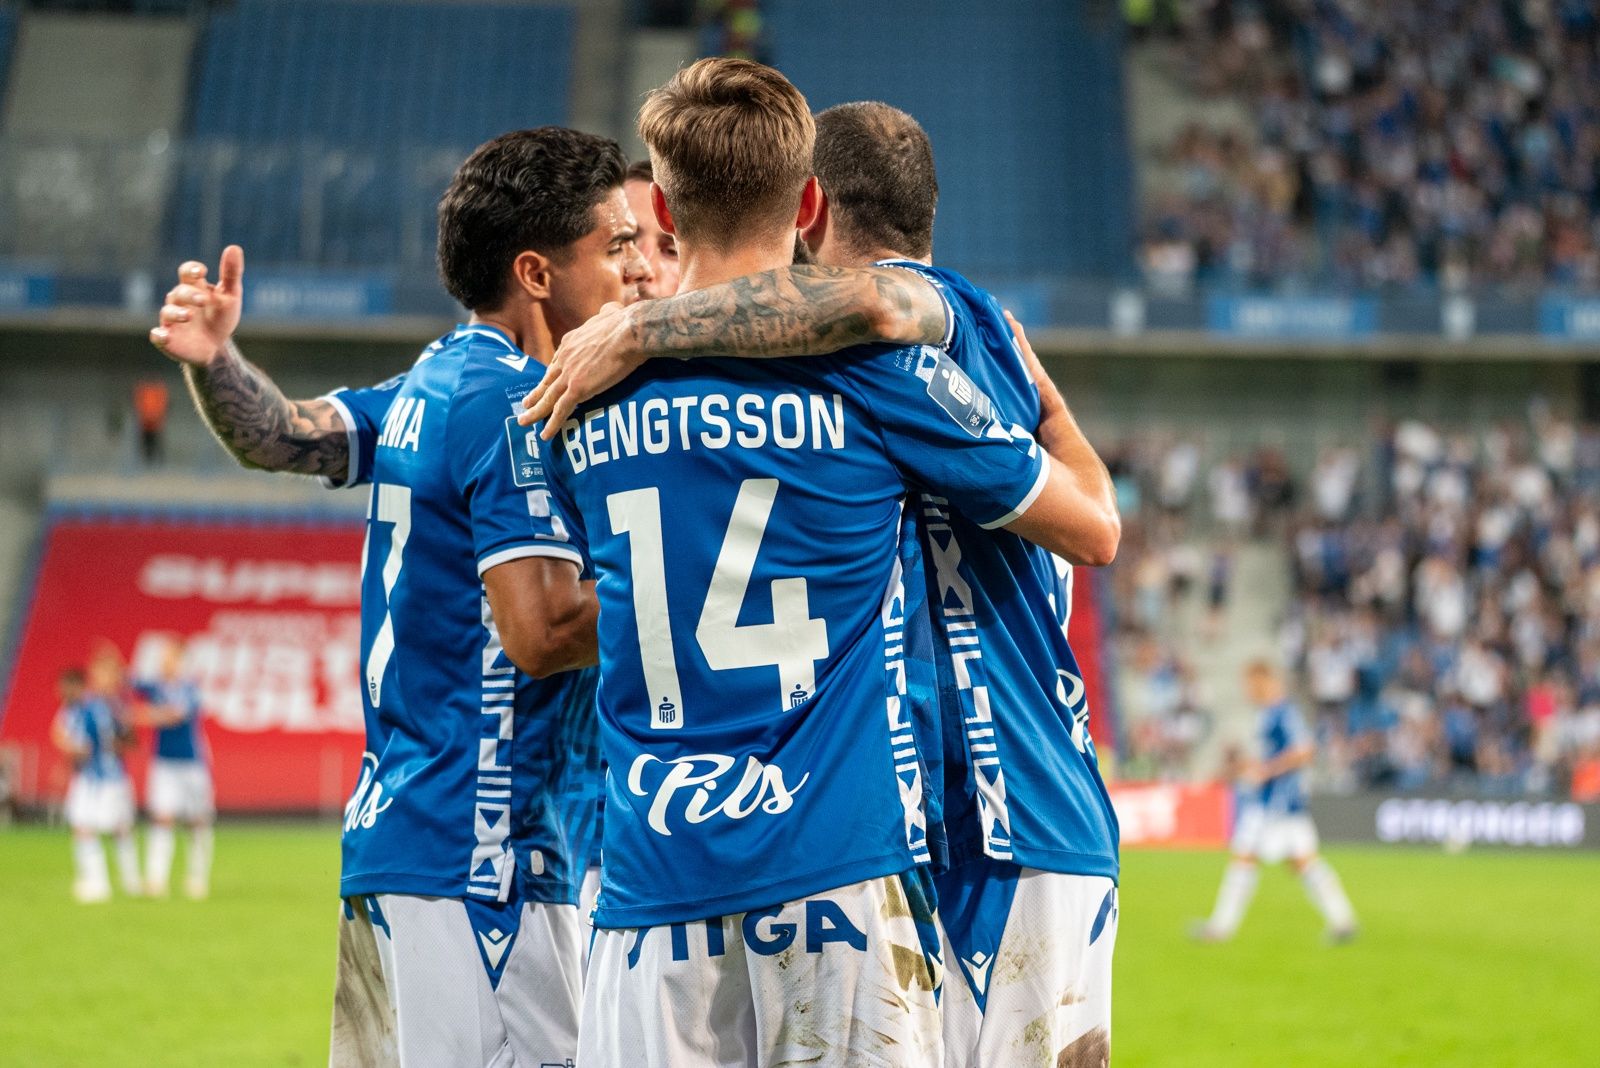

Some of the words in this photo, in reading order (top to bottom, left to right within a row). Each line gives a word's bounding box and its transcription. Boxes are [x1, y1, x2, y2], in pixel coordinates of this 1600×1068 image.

[377, 397, 426, 452] MA
[561, 392, 846, 475] BENGTSSON
[361, 482, 412, 708] 7
[606, 478, 830, 730] 14
[627, 753, 810, 836] Pils
